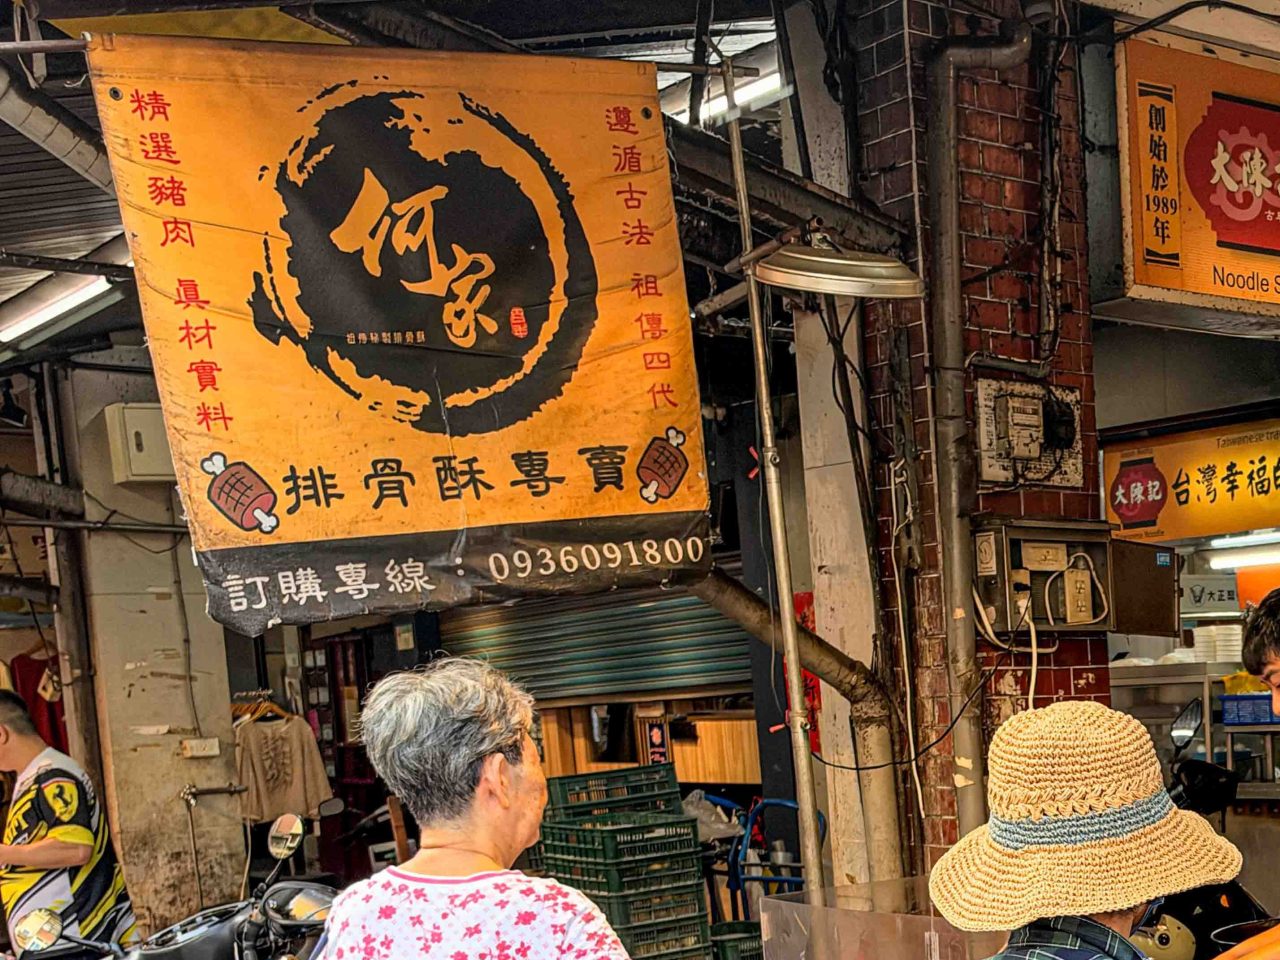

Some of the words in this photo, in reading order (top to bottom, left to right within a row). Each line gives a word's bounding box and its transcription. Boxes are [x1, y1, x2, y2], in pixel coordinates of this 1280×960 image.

[130, 89, 195, 247] 精選豬肉
[1145, 103, 1178, 245] 創始於1989年
[331, 167, 498, 348] 何家
[606, 106, 655, 245] 遵循古法
[631, 272, 679, 409] 祖傳四代
[1212, 265, 1270, 292] Noodle
[282, 444, 631, 516] 排骨酥專賣
[1114, 479, 1163, 506] 大陳記
[487, 535, 706, 584] 0936091800
